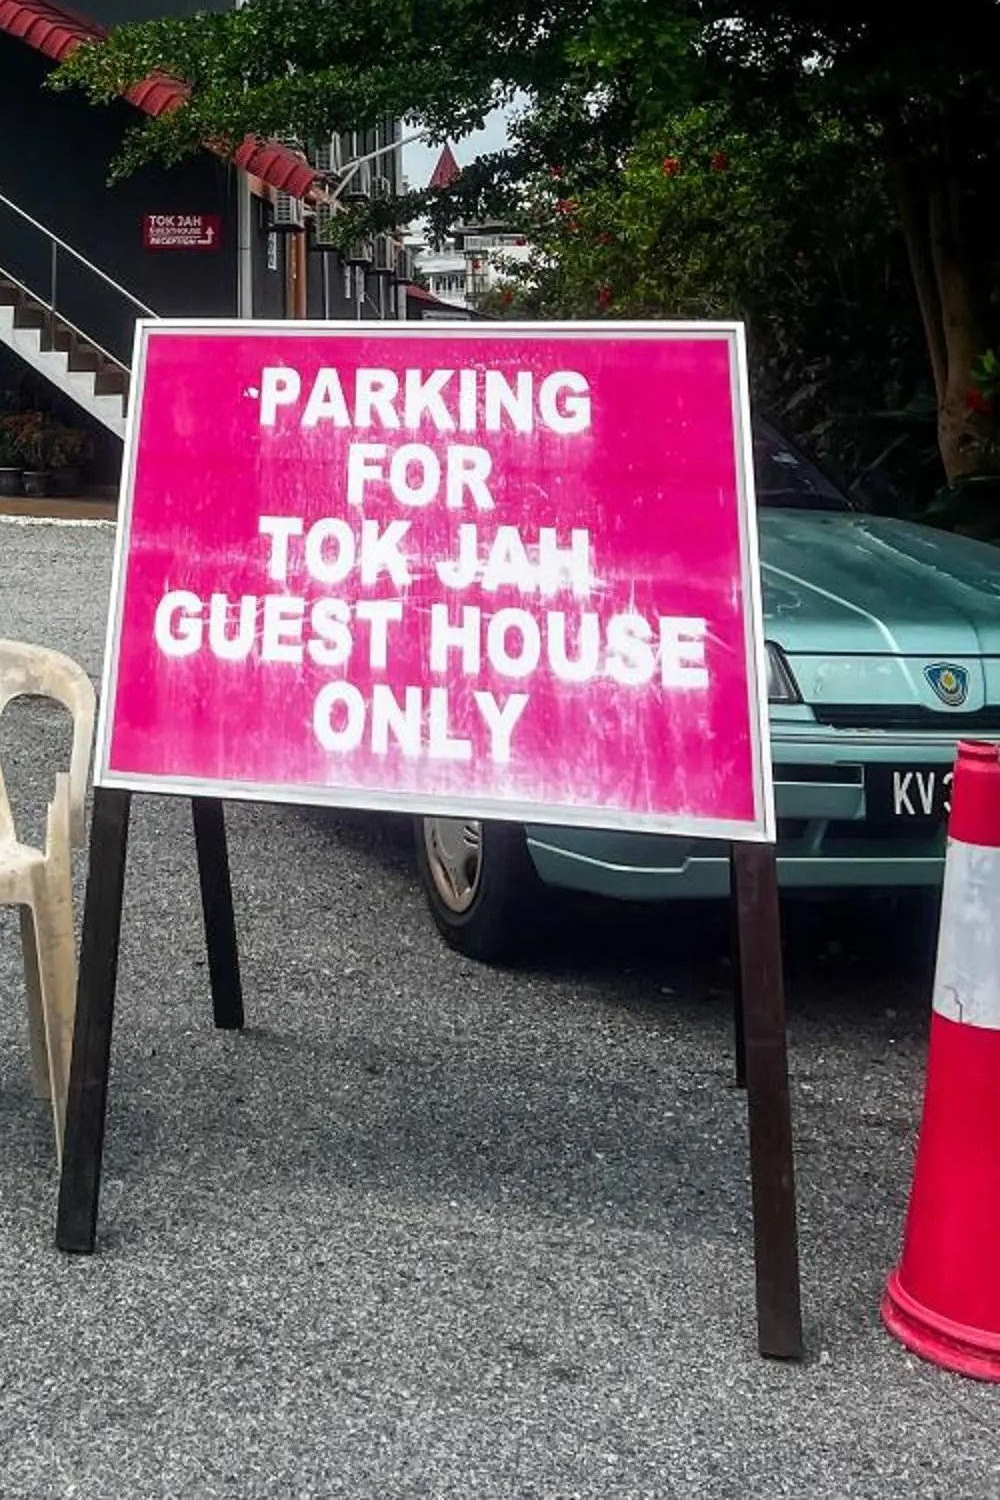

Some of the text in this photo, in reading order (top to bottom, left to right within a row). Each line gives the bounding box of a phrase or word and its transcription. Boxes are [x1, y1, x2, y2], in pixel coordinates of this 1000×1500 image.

[149, 215, 202, 227] TOK JAH
[258, 367, 593, 435] PARKING
[346, 443, 495, 510] FOR
[258, 515, 594, 596] TOK JAH
[153, 591, 709, 690] GUEST HOUSE
[312, 681, 530, 764] ONLY
